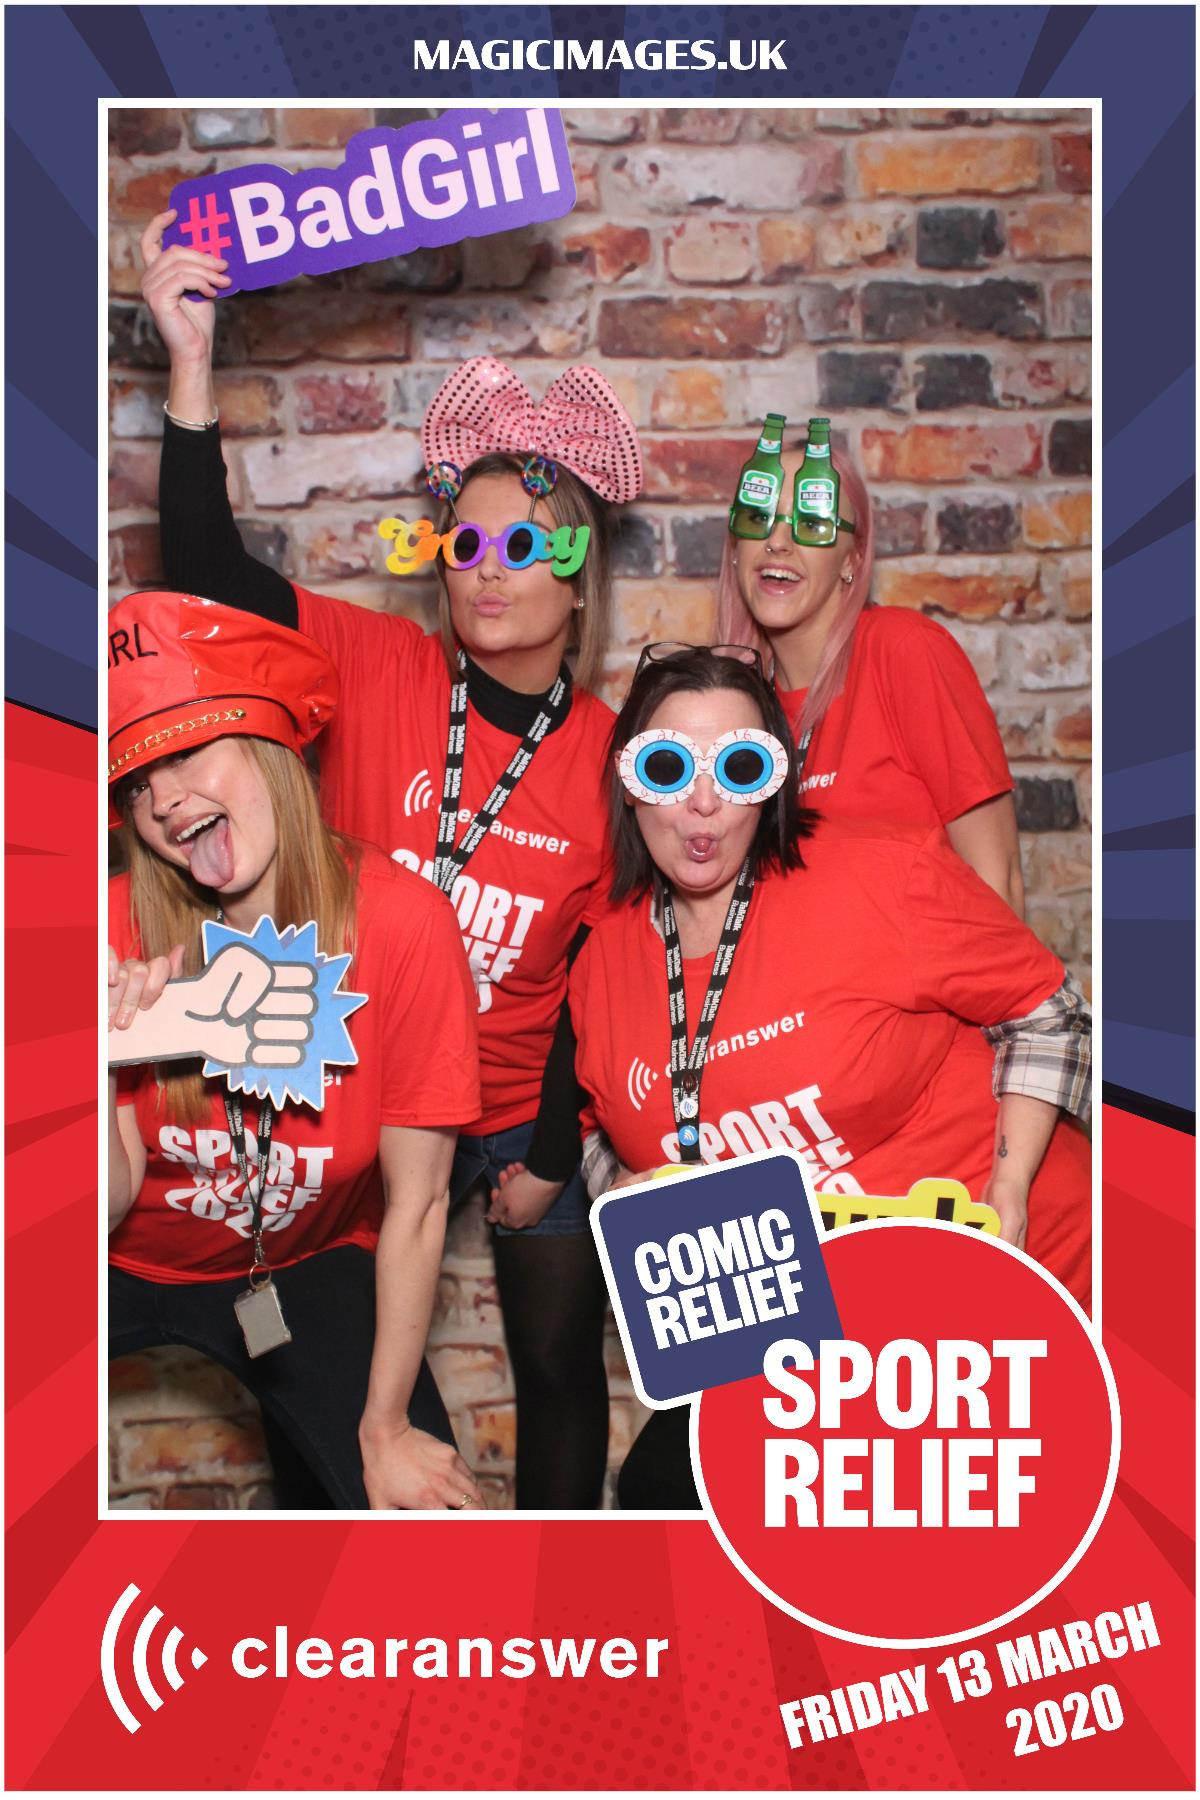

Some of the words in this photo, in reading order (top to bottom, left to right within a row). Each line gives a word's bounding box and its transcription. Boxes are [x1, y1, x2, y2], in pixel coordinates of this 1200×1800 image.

[180, 108, 561, 264] #BadGirl
[744, 483, 771, 495] BEER
[802, 492, 831, 500] BEER
[159, 1126, 334, 1188] SPORT
